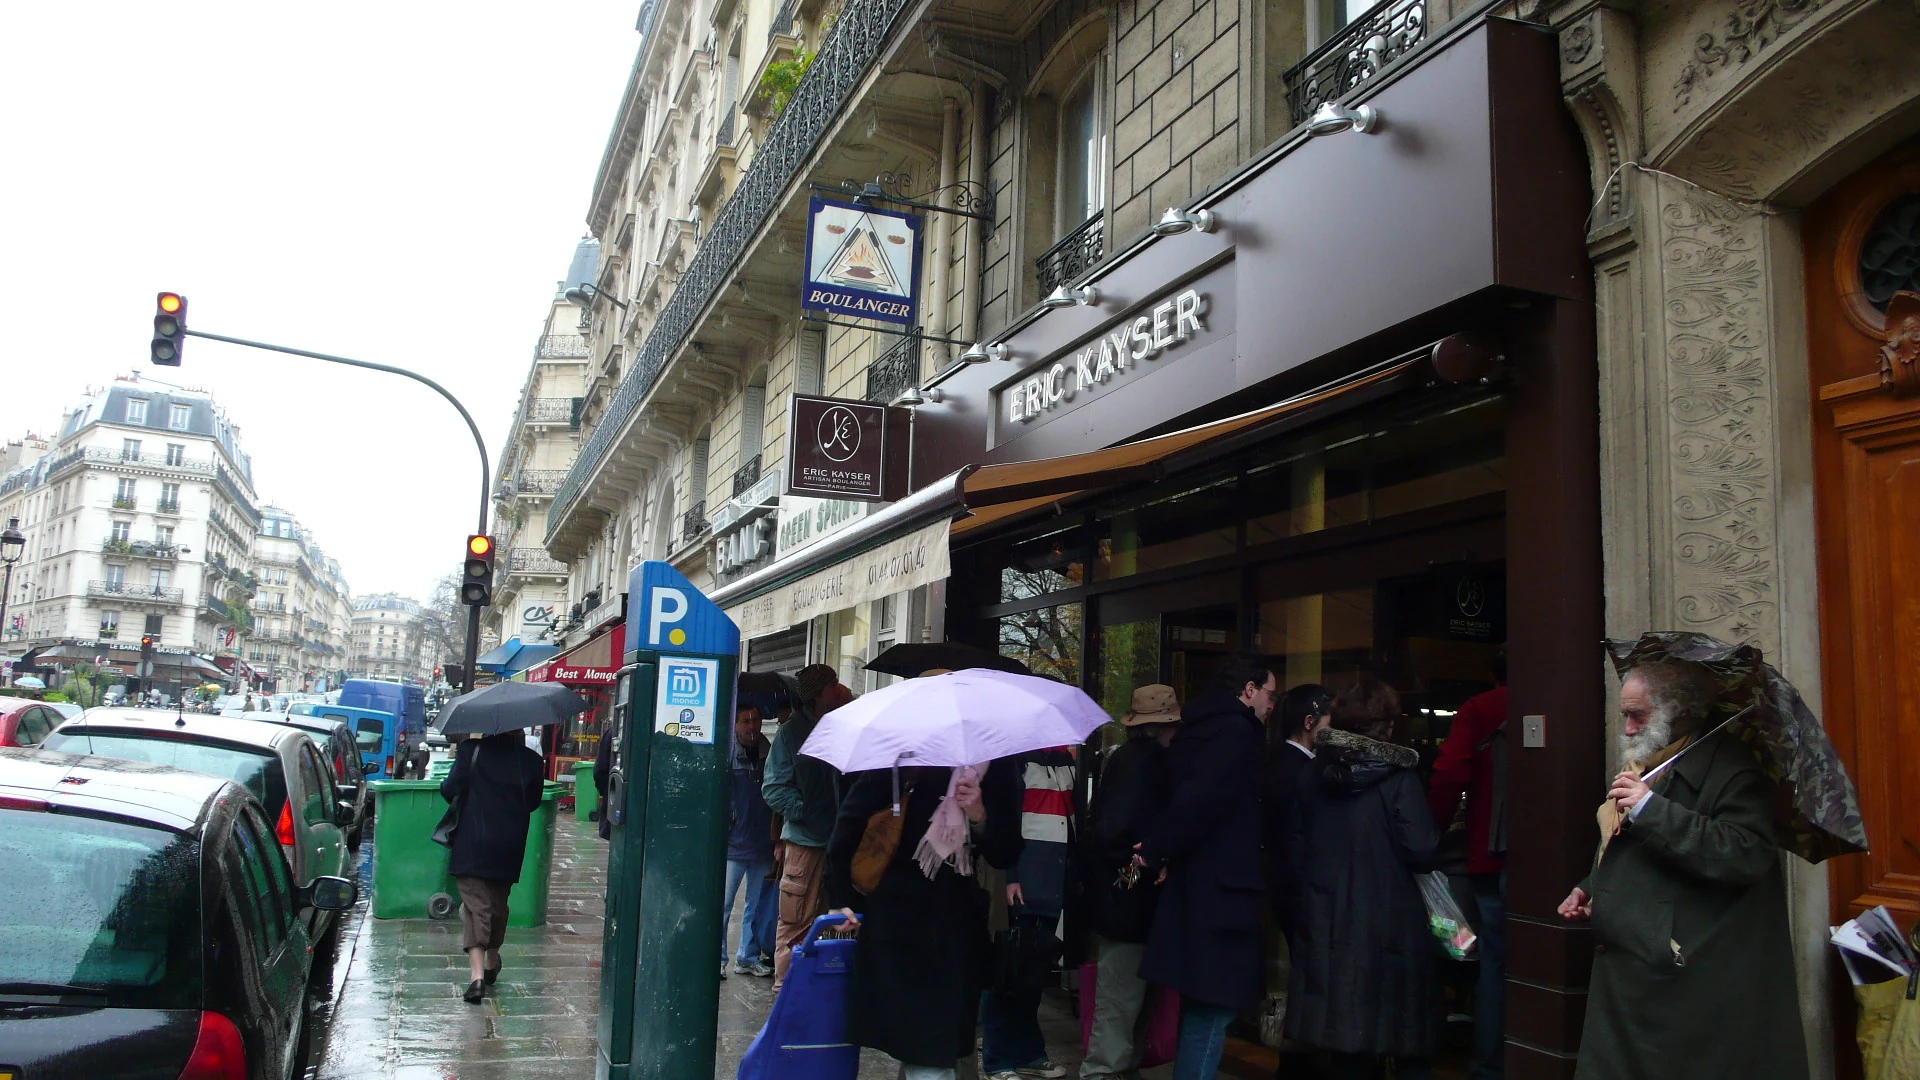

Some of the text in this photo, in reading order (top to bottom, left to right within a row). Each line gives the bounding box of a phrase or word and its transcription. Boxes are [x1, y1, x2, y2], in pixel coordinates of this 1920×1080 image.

[809, 290, 910, 317] BOULANGER
[1010, 289, 1201, 422] ERIC KAYSER
[803, 467, 871, 481] ERIC KAYSER
[803, 475, 871, 487] ARTISAN BOULANGER
[780, 508, 811, 551] GREEN
[793, 574, 843, 611] BOULANGERIE
[649, 587, 688, 645] P
[156, 647, 191, 656] BRASSERIE
[555, 667, 578, 679] Best
[584, 668, 617, 682] Monge
[672, 697, 700, 705] moneo
